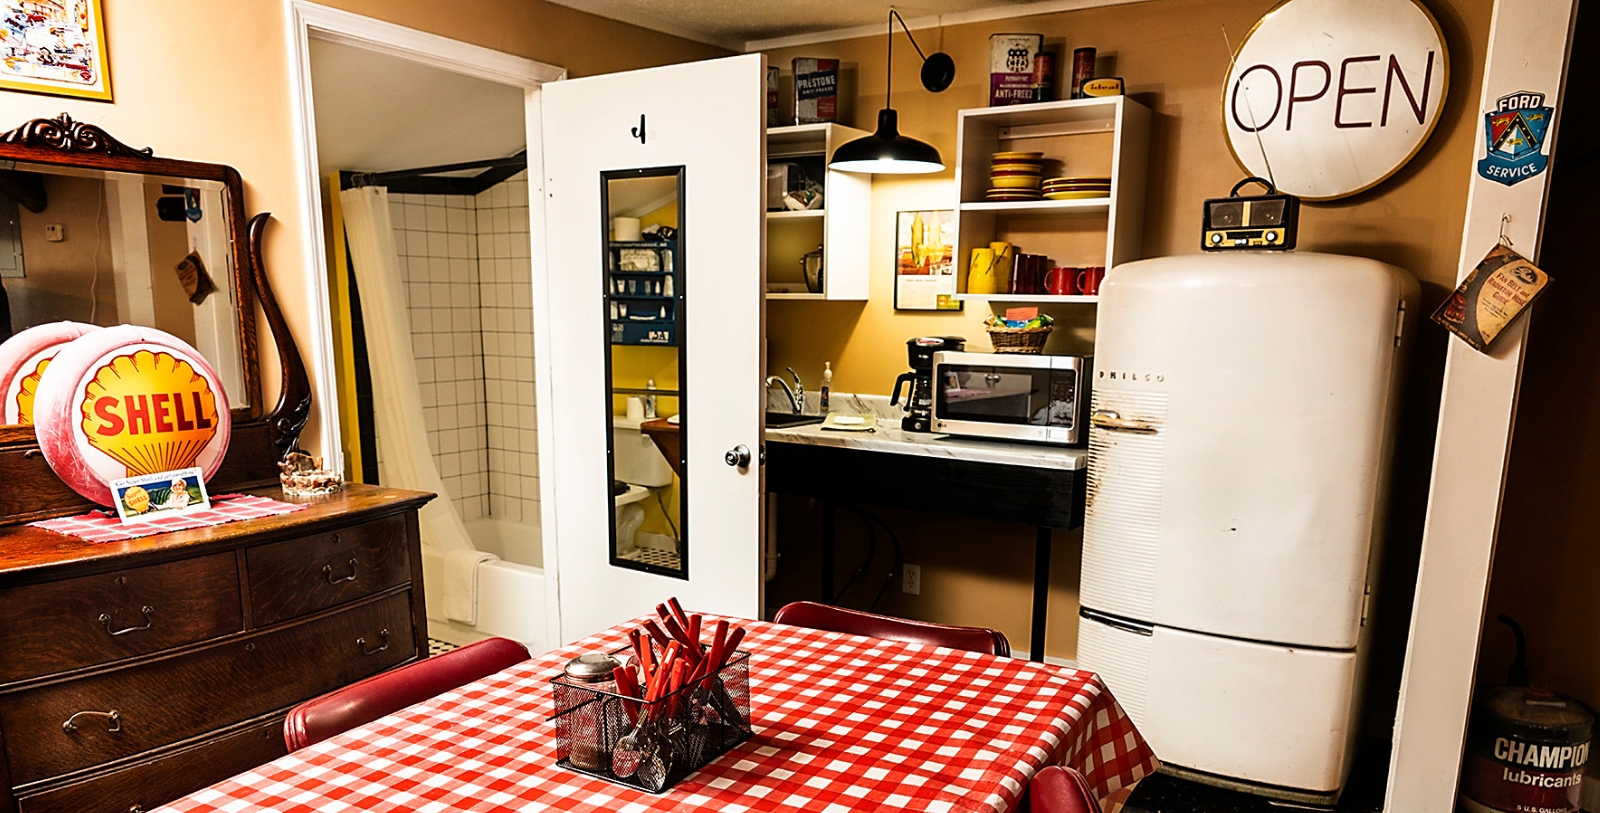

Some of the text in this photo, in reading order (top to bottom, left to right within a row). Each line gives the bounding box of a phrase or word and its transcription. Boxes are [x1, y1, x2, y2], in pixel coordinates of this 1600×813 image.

[797, 75, 836, 90] PRESTONE
[994, 89, 1033, 99] ANTI-FREEZ
[1231, 51, 1435, 132] OPEN
[1499, 95, 1541, 112] FORD
[1486, 163, 1538, 178] SERVICE
[1487, 277, 1527, 306] RADIATOR HOSE
[1507, 279, 1521, 291] BELT
[94, 391, 212, 436] SHELL
[128, 495, 148, 506] SHELL
[1494, 737, 1591, 769] CHAMPION
[1503, 767, 1582, 788] lubricants
